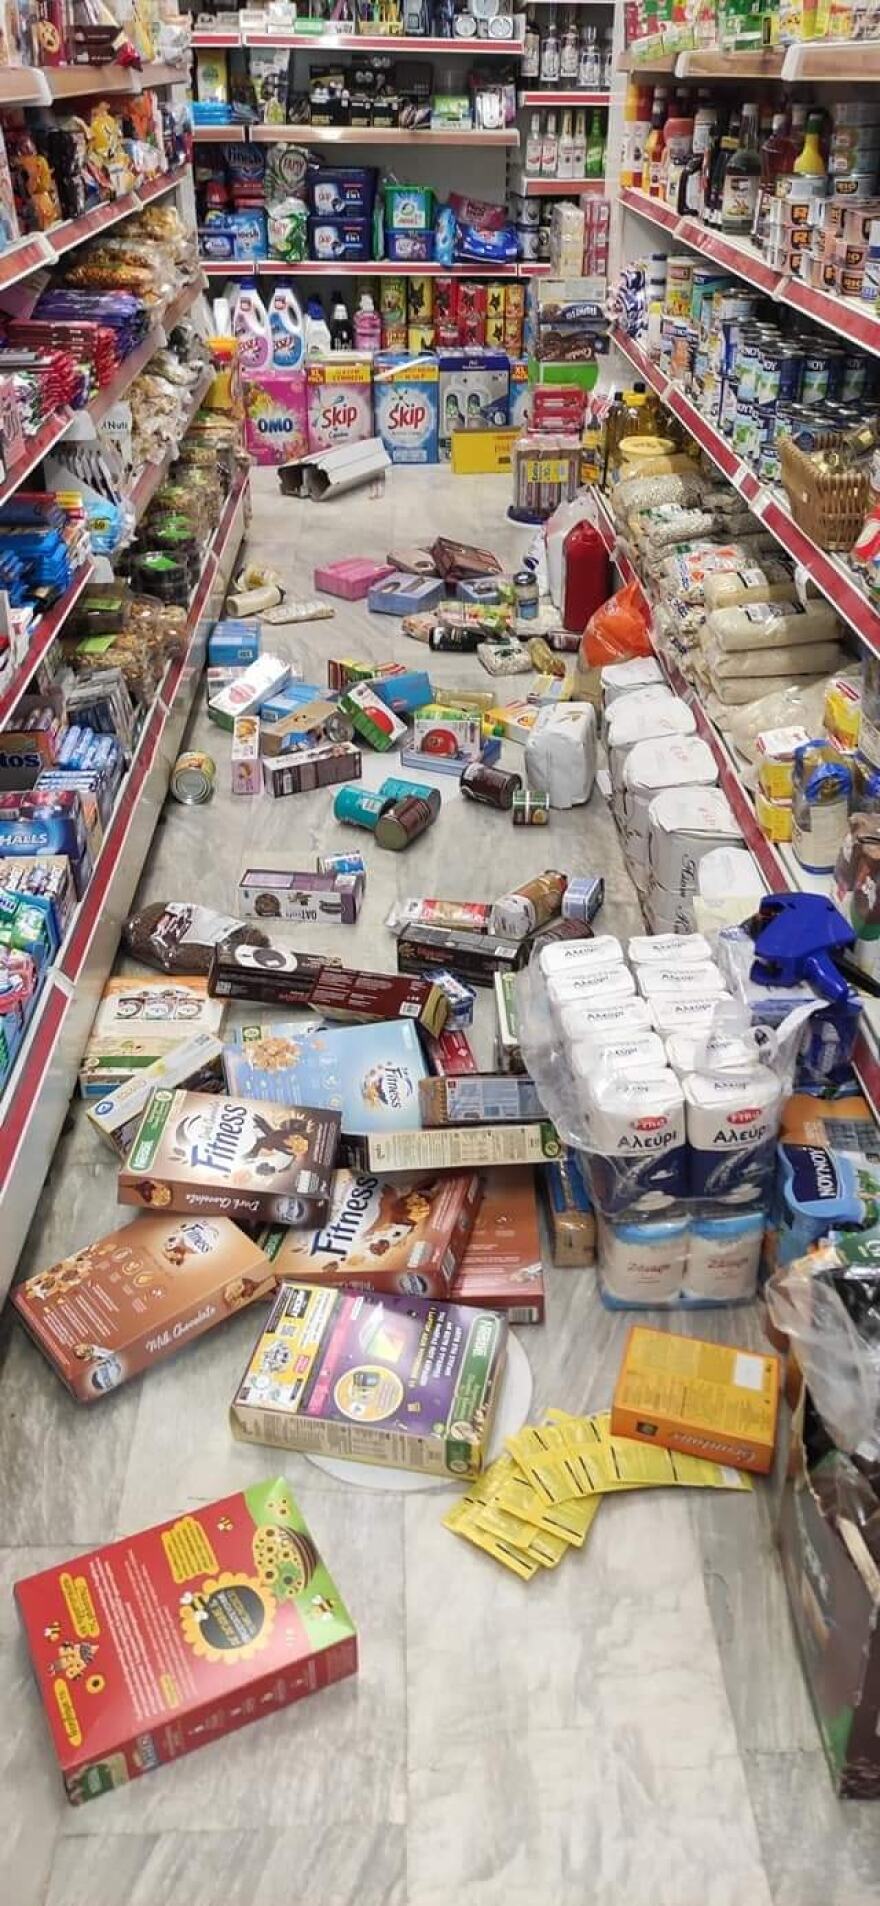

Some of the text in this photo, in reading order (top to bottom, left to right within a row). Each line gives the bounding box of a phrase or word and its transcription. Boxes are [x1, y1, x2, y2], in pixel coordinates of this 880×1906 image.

[258, 418, 293, 433] OMO
[322, 403, 357, 429] Skip
[388, 404, 425, 430] Skip
[0, 832, 48, 846] HALLS
[190, 1103, 248, 1175] Fitness
[617, 1131, 678, 1149] Αλεύρι
[311, 1176, 379, 1259] Fitness
